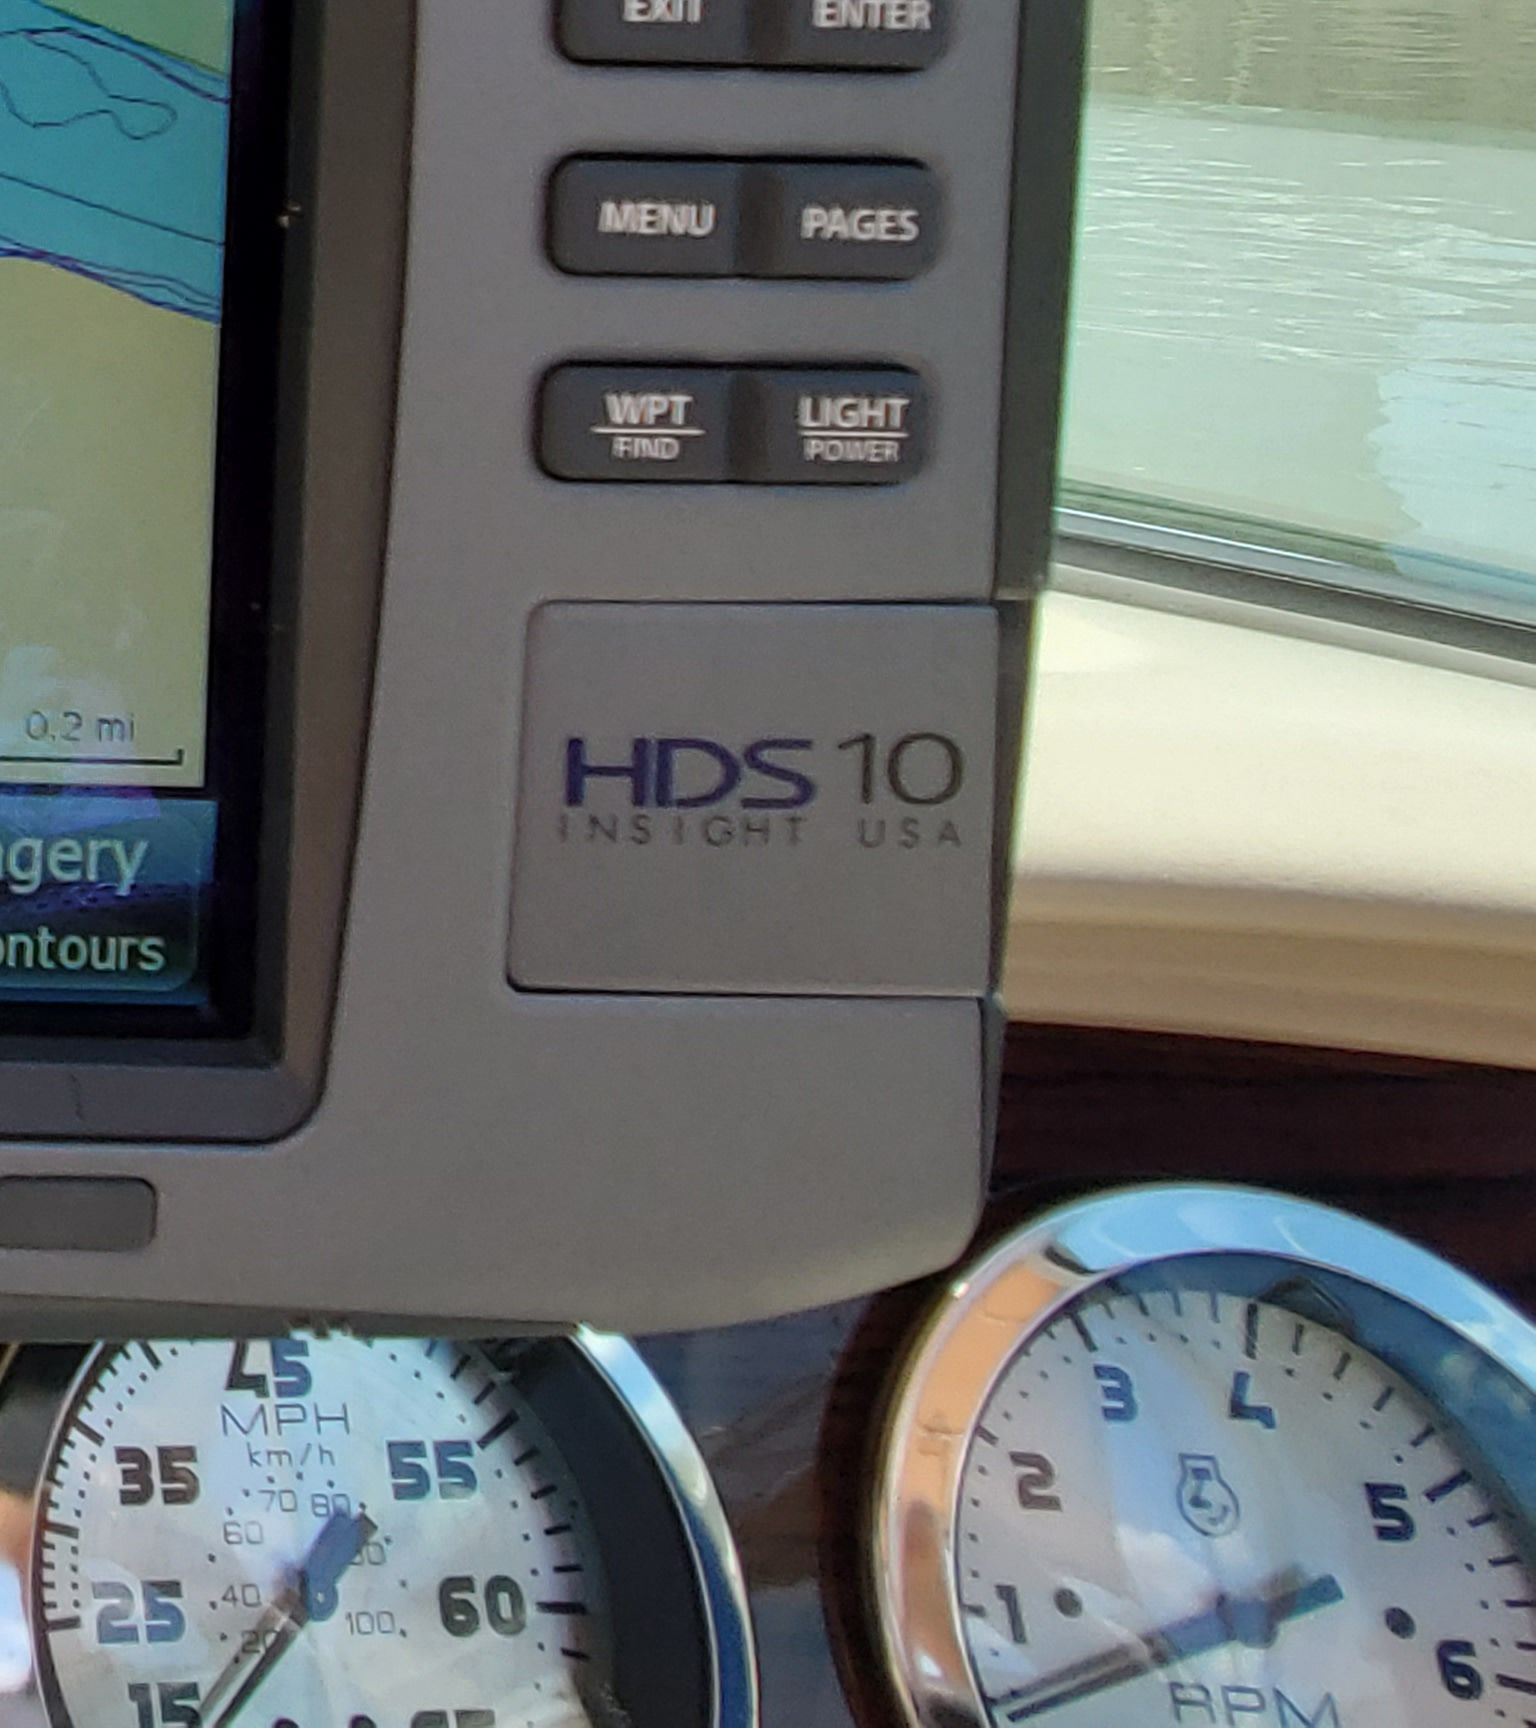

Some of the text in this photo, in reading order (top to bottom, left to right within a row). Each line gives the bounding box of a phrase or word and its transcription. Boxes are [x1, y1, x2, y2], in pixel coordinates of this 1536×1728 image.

[598, 202, 716, 236] MENU
[801, 205, 919, 242] PAGES
[603, 394, 694, 425] WPT
[797, 396, 910, 428] LIGHT
[612, 438, 680, 461] FIND
[803, 440, 900, 463] POWER
[26, 711, 136, 743] 0.2 mi
[565, 732, 965, 809] HDS 10
[558, 814, 962, 850] INSIGHT USA
[224, 1336, 314, 1399] 45
[1093, 1363, 1137, 1422] 3
[221, 1402, 350, 1437] MPH
[245, 1441, 337, 1469] km/h
[387, 1439, 480, 1502] 55
[114, 1445, 200, 1506] 35
[1009, 1451, 1062, 1512] 2
[256, 1489, 298, 1513] 70
[1364, 1482, 1415, 1542] 5
[222, 1520, 264, 1546] 60
[90, 1578, 188, 1646] 25
[221, 1582, 262, 1608] 40
[438, 1573, 528, 1638] 60
[344, 1610, 396, 1636] 100
[1435, 1639, 1484, 1700] 6
[127, 1681, 202, 1728] 15
[1168, 1680, 1340, 1728] RPM
